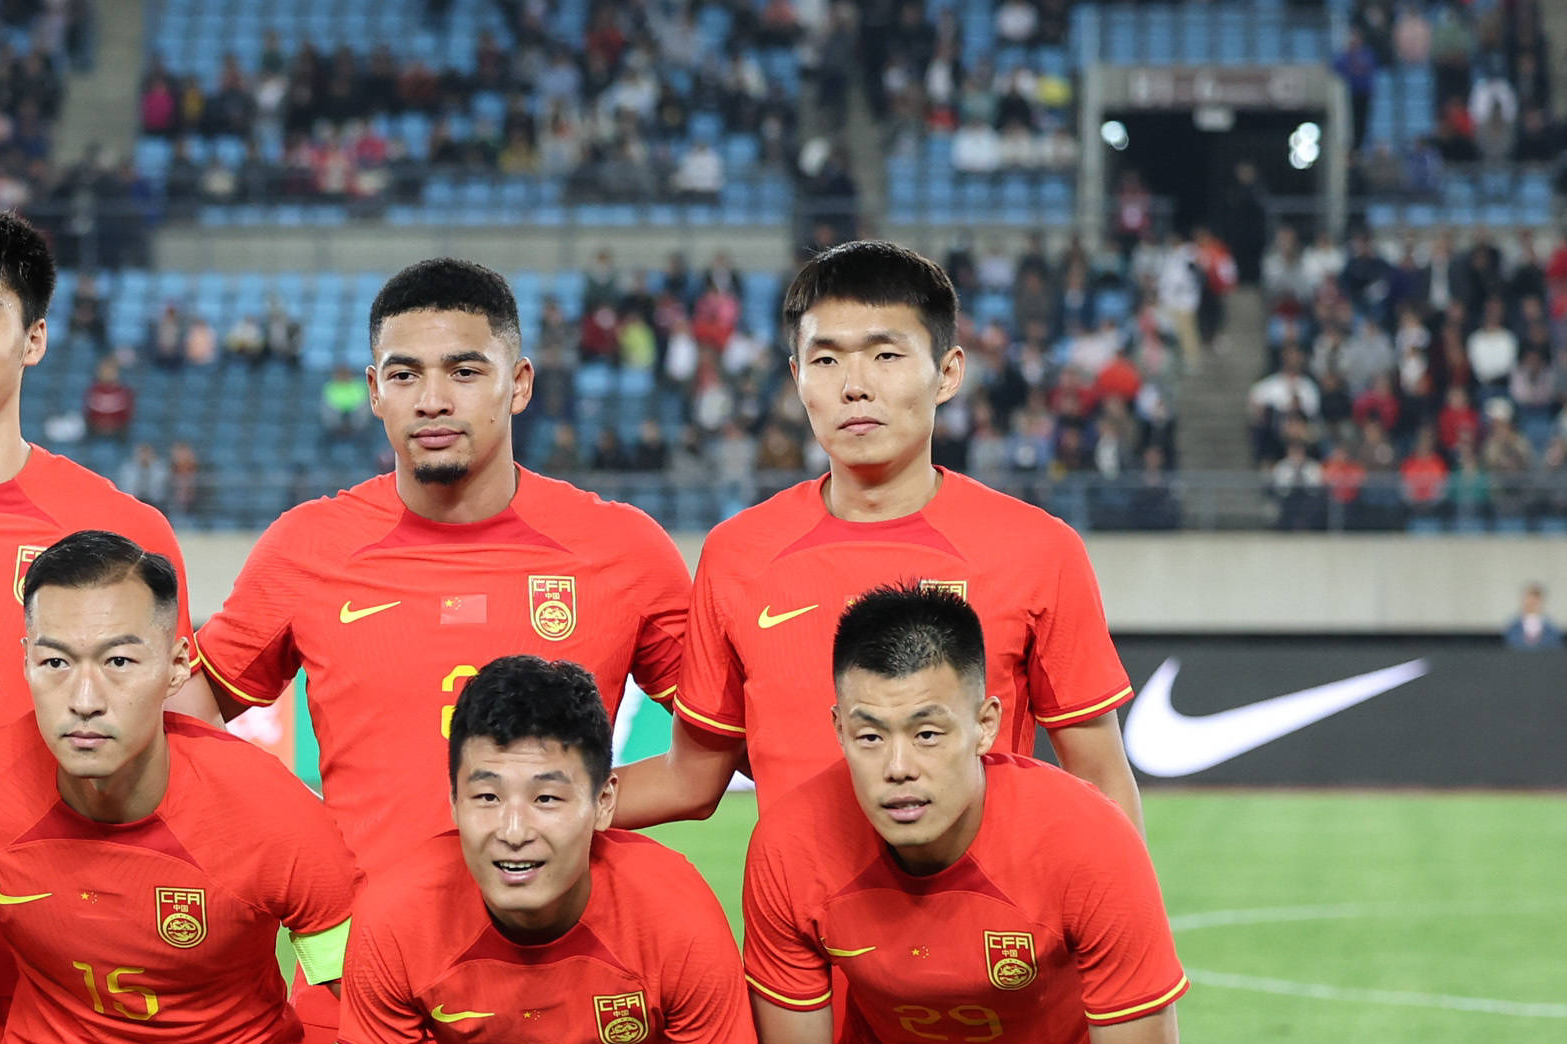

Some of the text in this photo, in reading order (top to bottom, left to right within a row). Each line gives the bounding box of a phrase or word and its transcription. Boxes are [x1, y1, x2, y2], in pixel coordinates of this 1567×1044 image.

[533, 580, 572, 592] CFA
[161, 891, 200, 905] CFA
[989, 936, 1029, 949] CFA
[72, 960, 159, 1021] 15
[599, 996, 640, 1011] CFA
[893, 1005, 1003, 1042] 29
